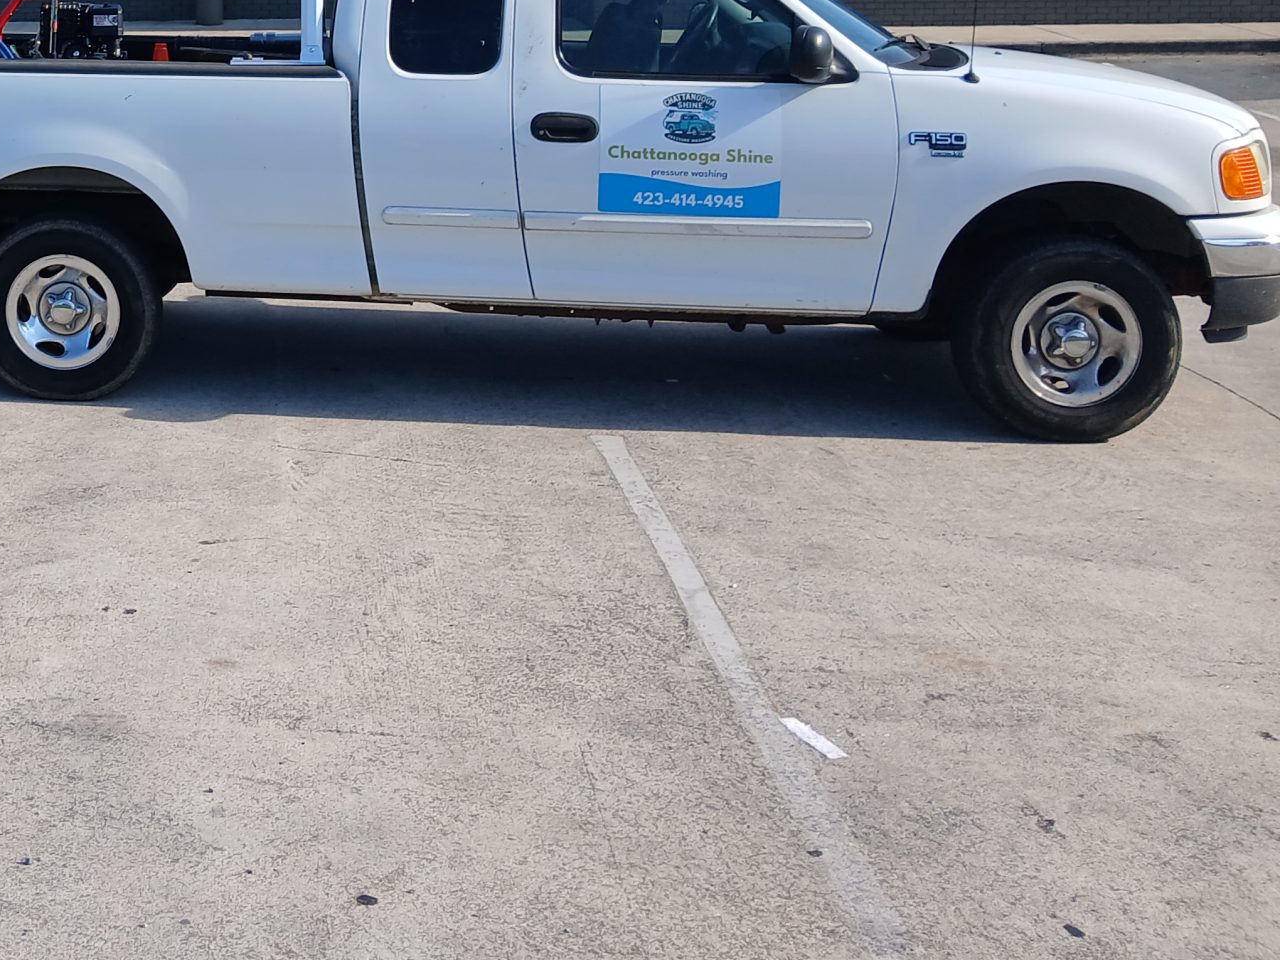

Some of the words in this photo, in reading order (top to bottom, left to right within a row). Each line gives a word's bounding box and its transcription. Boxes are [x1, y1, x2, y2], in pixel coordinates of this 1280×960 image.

[664, 93, 716, 108] CHATTANOOGA
[677, 102, 705, 110] SHINE
[607, 145, 720, 166] Chattanooga
[726, 149, 774, 164] Shine
[651, 169, 689, 178] pressure
[691, 169, 728, 180] washing
[633, 191, 744, 209] 423-414-4945
